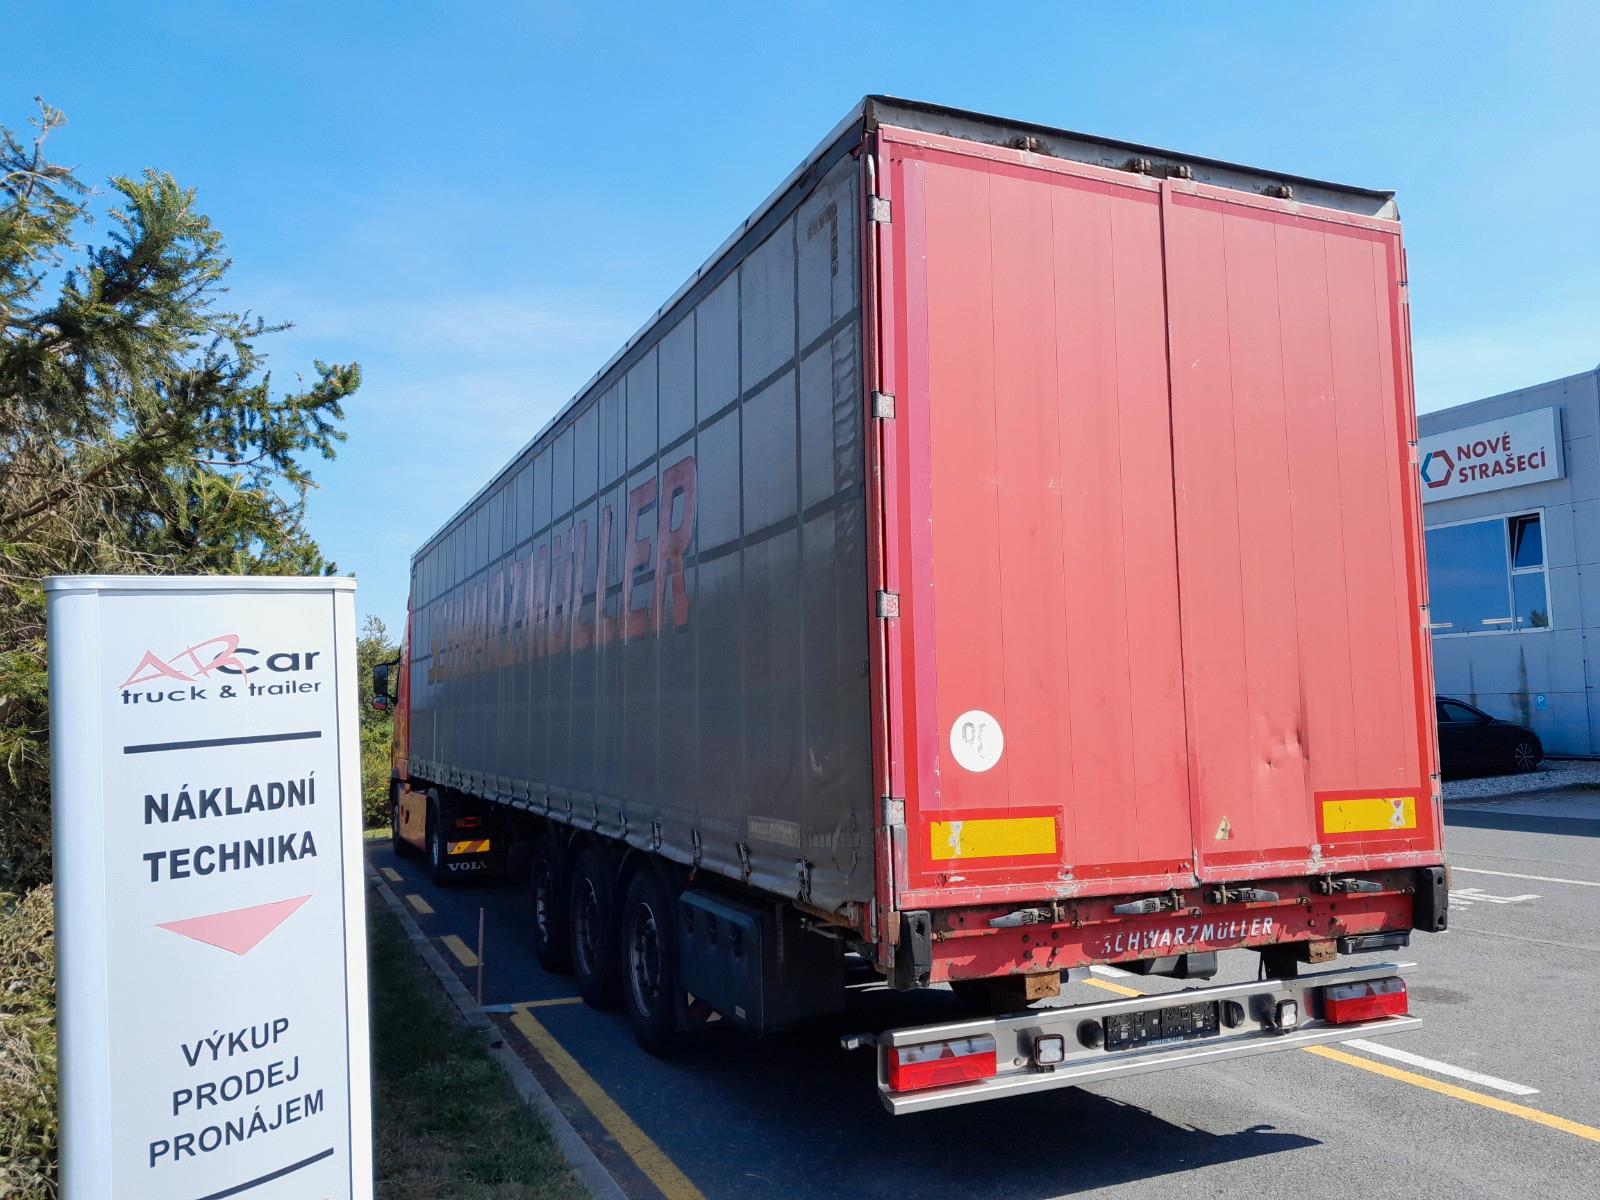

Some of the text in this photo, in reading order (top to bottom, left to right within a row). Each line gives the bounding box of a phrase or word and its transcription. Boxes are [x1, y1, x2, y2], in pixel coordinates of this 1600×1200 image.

[1457, 431, 1511, 461] NOVÉ
[1459, 446, 1546, 484] STRAŠECÍ
[121, 680, 321, 704] truck & trailer
[144, 771, 315, 825] NÁKLADNÍ
[143, 830, 317, 882] TECHNIKA
[181, 1017, 289, 1067] VÝKUP
[173, 1056, 299, 1116] PRODEJ
[150, 1088, 324, 1168] PRONÁJEM
